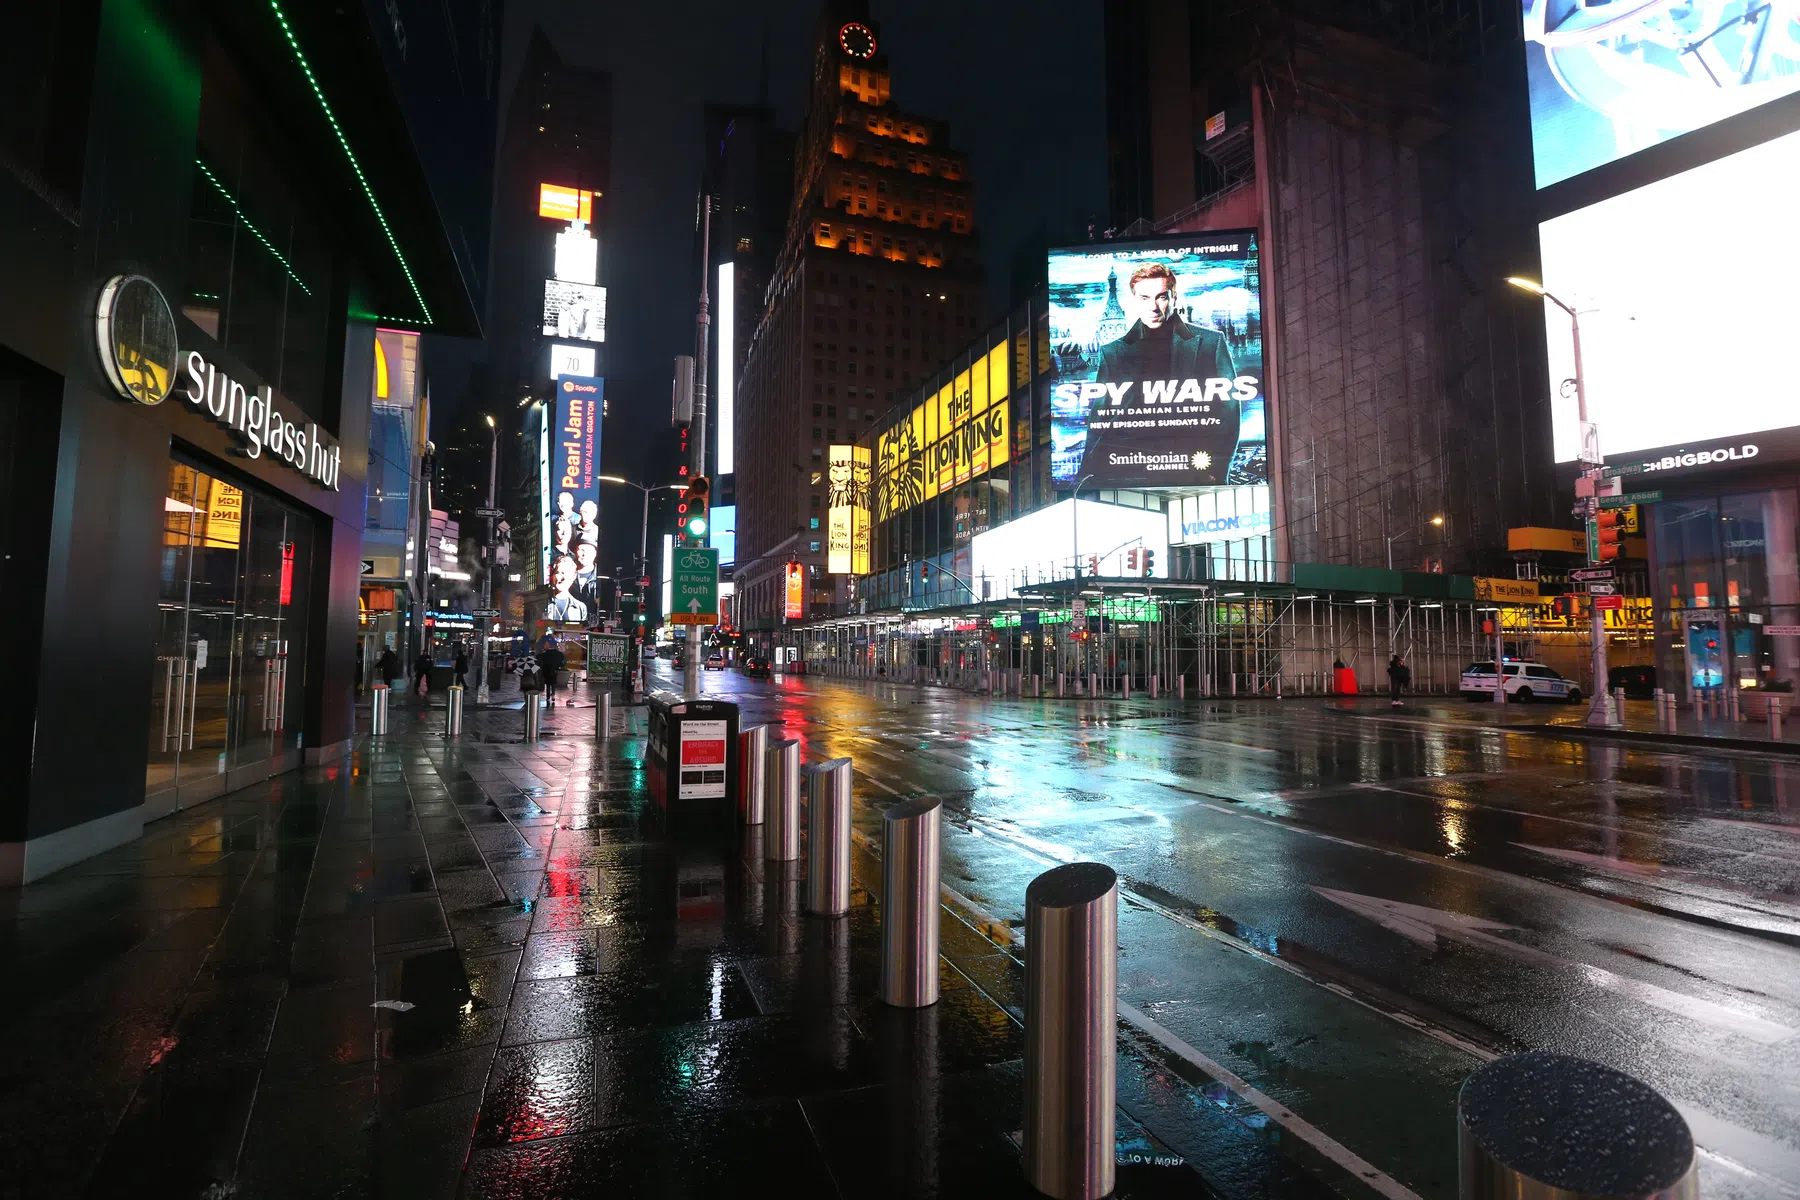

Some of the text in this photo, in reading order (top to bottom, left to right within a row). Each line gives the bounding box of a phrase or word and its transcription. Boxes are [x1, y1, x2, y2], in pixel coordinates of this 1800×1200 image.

[1116, 251, 1130, 259] TO
[1132, 250, 1140, 258] A
[1141, 248, 1177, 258] WORLD
[1178, 247, 1192, 255] OF
[1194, 243, 1239, 254] INTRIGUE
[566, 357, 580, 371] 70
[575, 384, 597, 394] Spotify
[1053, 376, 1259, 408] SPY WARS
[947, 389, 970, 421] THE
[1097, 405, 1210, 417] WITH DAMIAN LEWIS
[187, 350, 341, 493] sunglass hut
[587, 401, 596, 434] GIGATON
[1090, 417, 1221, 430] NEW EPISODES SUNDAYS 8/7c
[562, 399, 583, 489] Pearl Jam
[586, 434, 594, 459] ALBUM
[928, 433, 961, 485] LION
[962, 409, 1003, 466] KING
[1109, 451, 1189, 465] Smithsonian
[679, 465, 688, 476] &
[1146, 462, 1189, 471] CHANNEL
[1604, 463, 1642, 478] Broadway
[1600, 492, 1659, 504] George Abbott
[831, 530, 847, 539] LION
[830, 540, 850, 551] KING
[1572, 538, 1585, 547] THE
[691, 575, 711, 583] Route
[681, 584, 709, 594] South
[1506, 585, 1520, 596] LION
[1521, 585, 1535, 597] KING
[1074, 611, 1084, 619] 25
[592, 644, 625, 658] BROADWAY'S
[591, 656, 624, 664] SECRETS
[687, 741, 720, 749] EMBRACE
[688, 756, 718, 764] ABSURD
